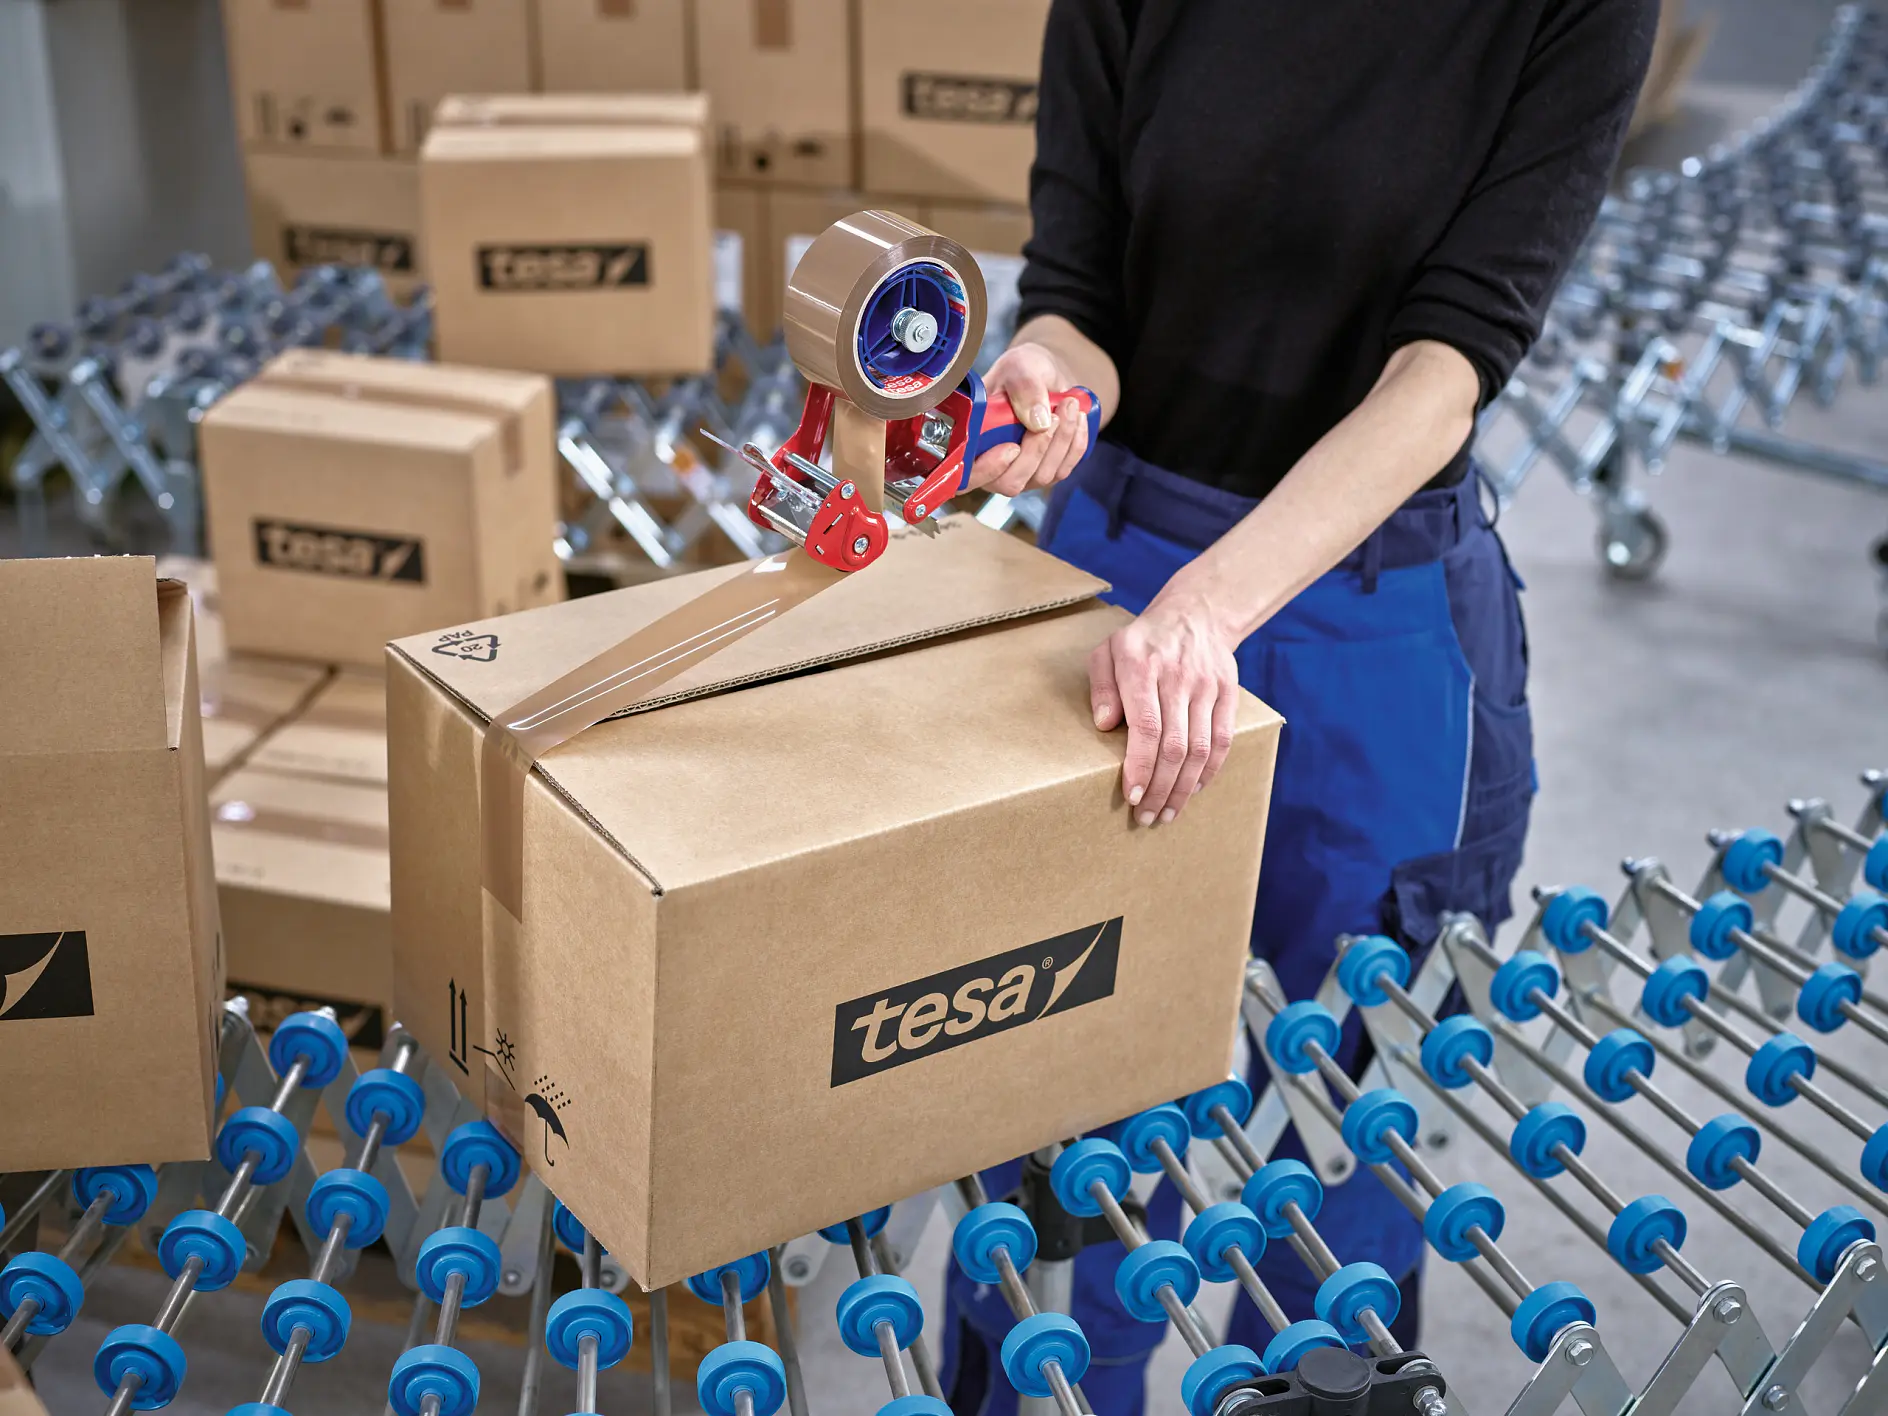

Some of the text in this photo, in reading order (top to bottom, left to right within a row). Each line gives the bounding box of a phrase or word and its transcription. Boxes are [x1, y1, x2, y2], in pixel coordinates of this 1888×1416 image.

[262, 528, 374, 575] tesa
[438, 630, 475, 642] PAP
[460, 643, 484, 653] 20
